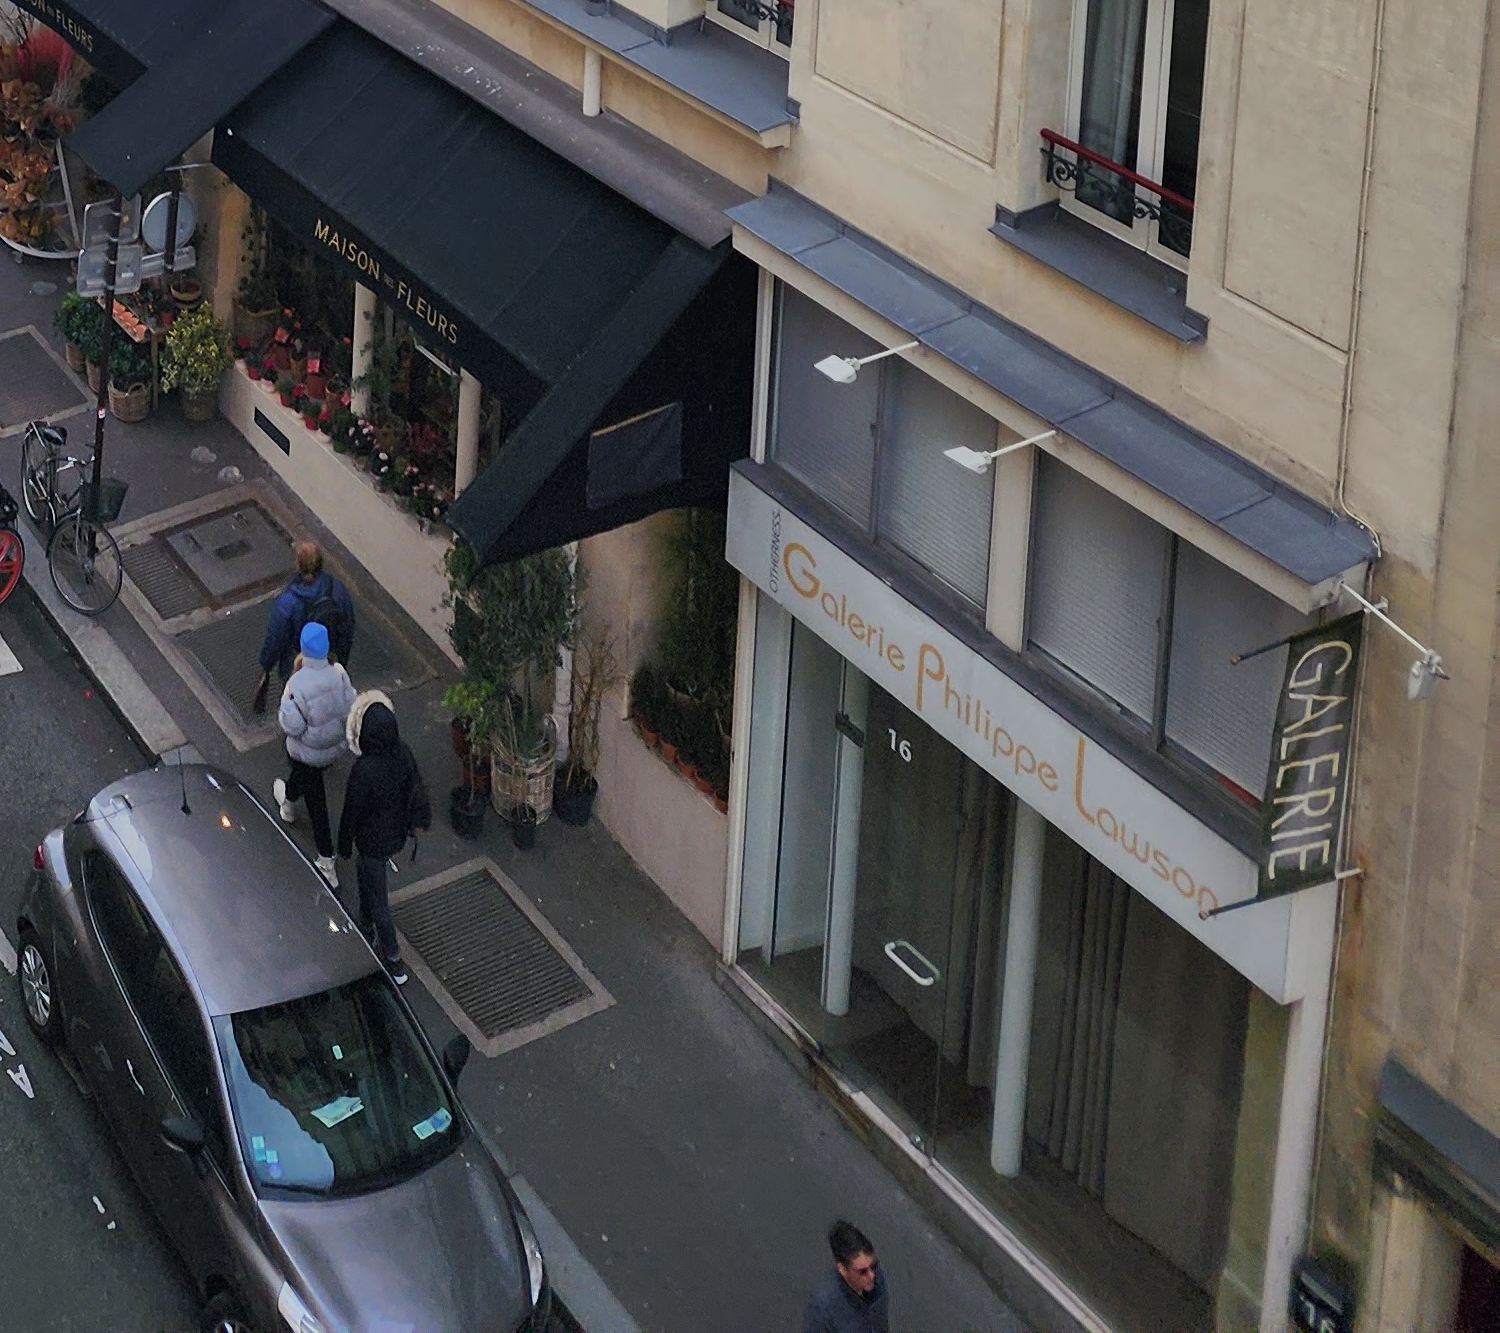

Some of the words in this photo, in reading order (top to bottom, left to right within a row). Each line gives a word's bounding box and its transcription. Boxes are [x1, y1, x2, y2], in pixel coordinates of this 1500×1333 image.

[56, 8, 94, 53] FLEURS
[314, 218, 380, 281] MAISON
[397, 281, 458, 345] FLEURS
[783, 542, 906, 672] Galerie
[916, 643, 1060, 792] Philippe
[1075, 735, 1219, 920] Lawson
[888, 728, 912, 763] 16
[1268, 639, 1353, 880] GALERIE
